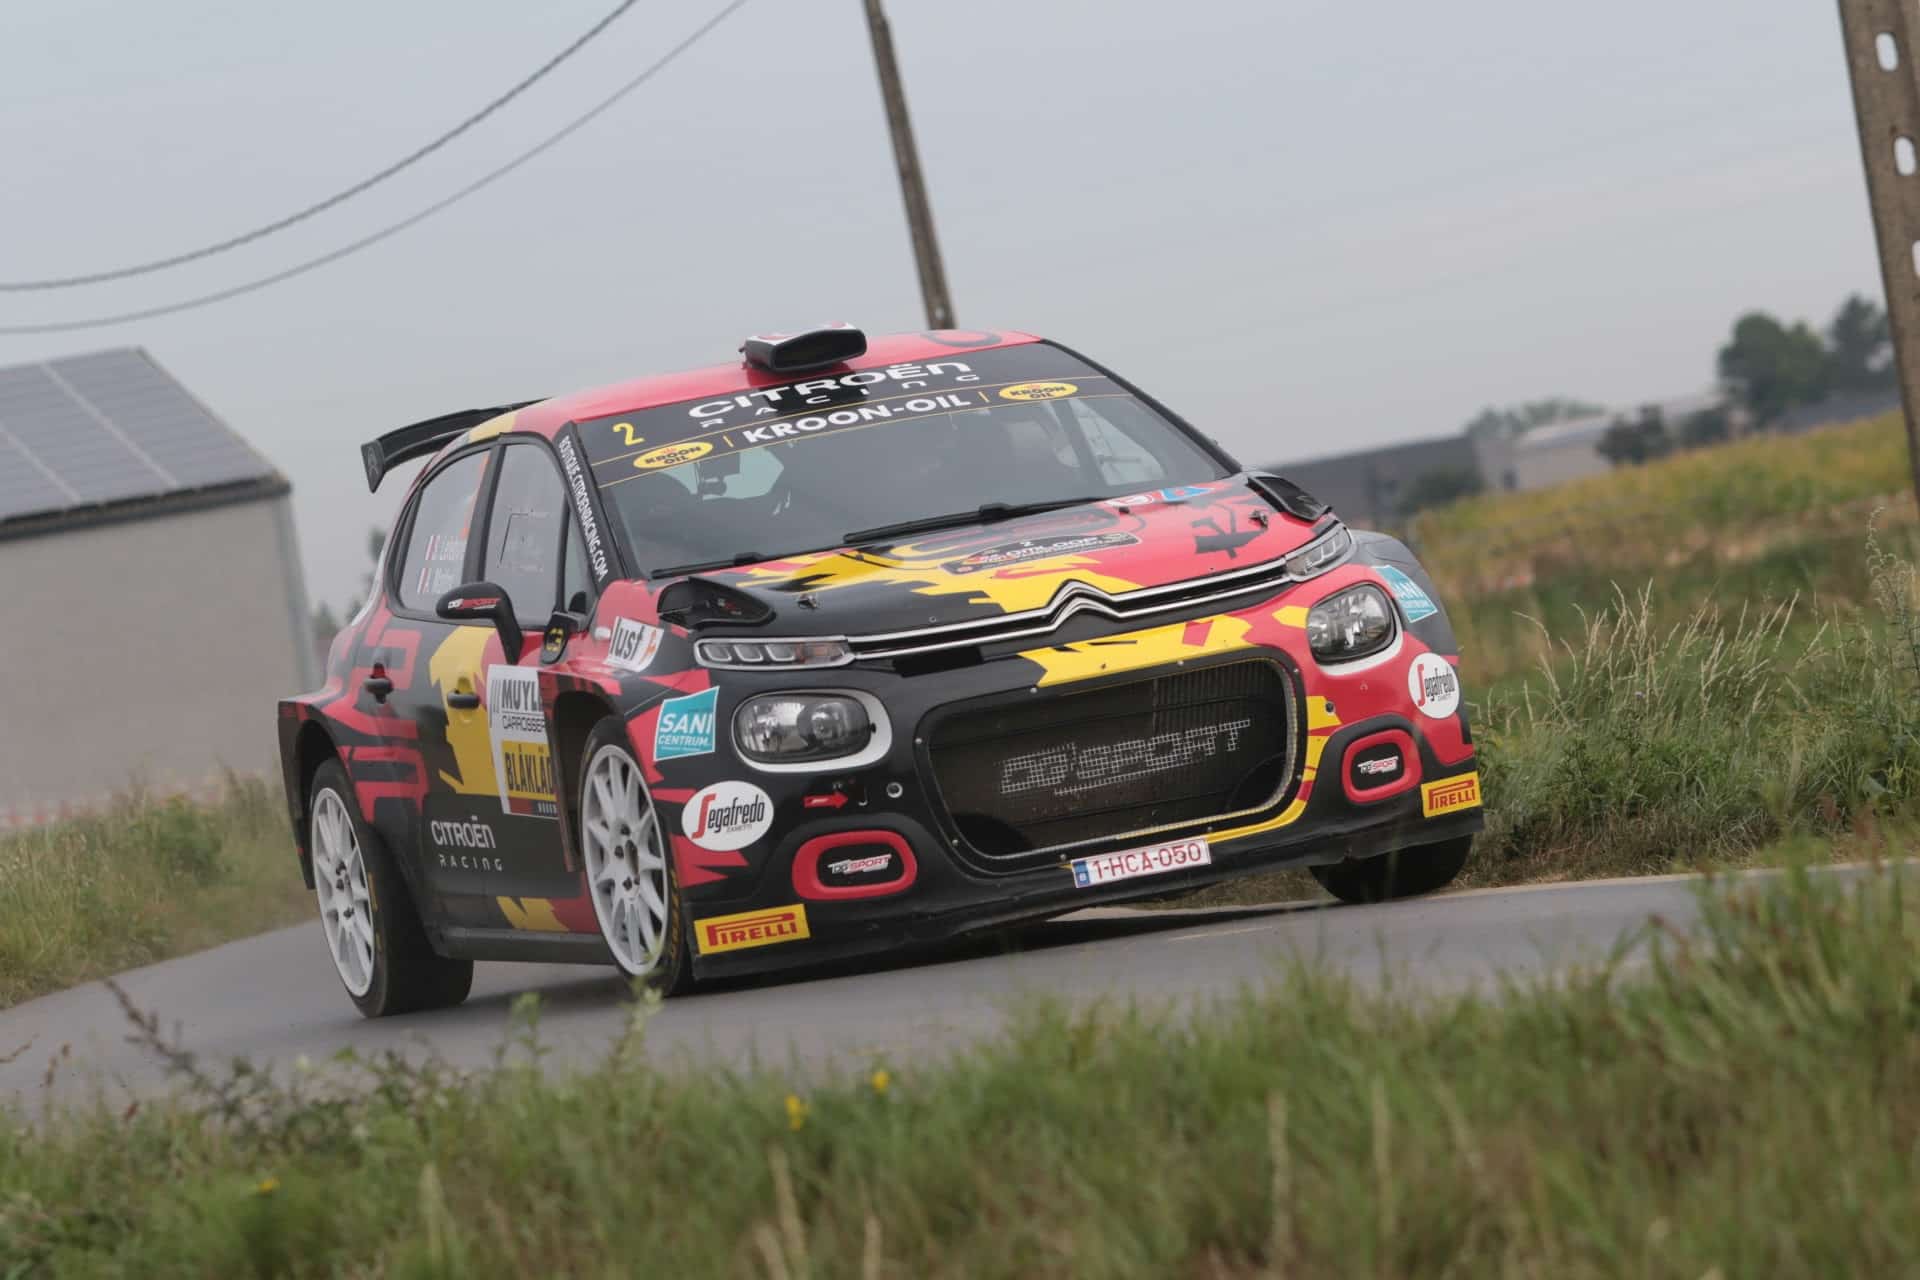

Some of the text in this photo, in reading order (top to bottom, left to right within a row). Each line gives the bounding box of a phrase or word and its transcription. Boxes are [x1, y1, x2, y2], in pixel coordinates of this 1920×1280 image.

[1010, 384, 1066, 397] KROON
[743, 394, 972, 443] KROON-OIL
[612, 422, 645, 447] 2
[644, 446, 701, 464] KROON
[664, 455, 689, 464] OIL
[660, 713, 713, 735] SANI
[1428, 779, 1476, 811] PIRELLI
[691, 793, 766, 839] Segafredo
[439, 853, 503, 872] RACING
[1092, 842, 1201, 879] 1-HCA-050
[706, 912, 798, 947] PIRELLI
